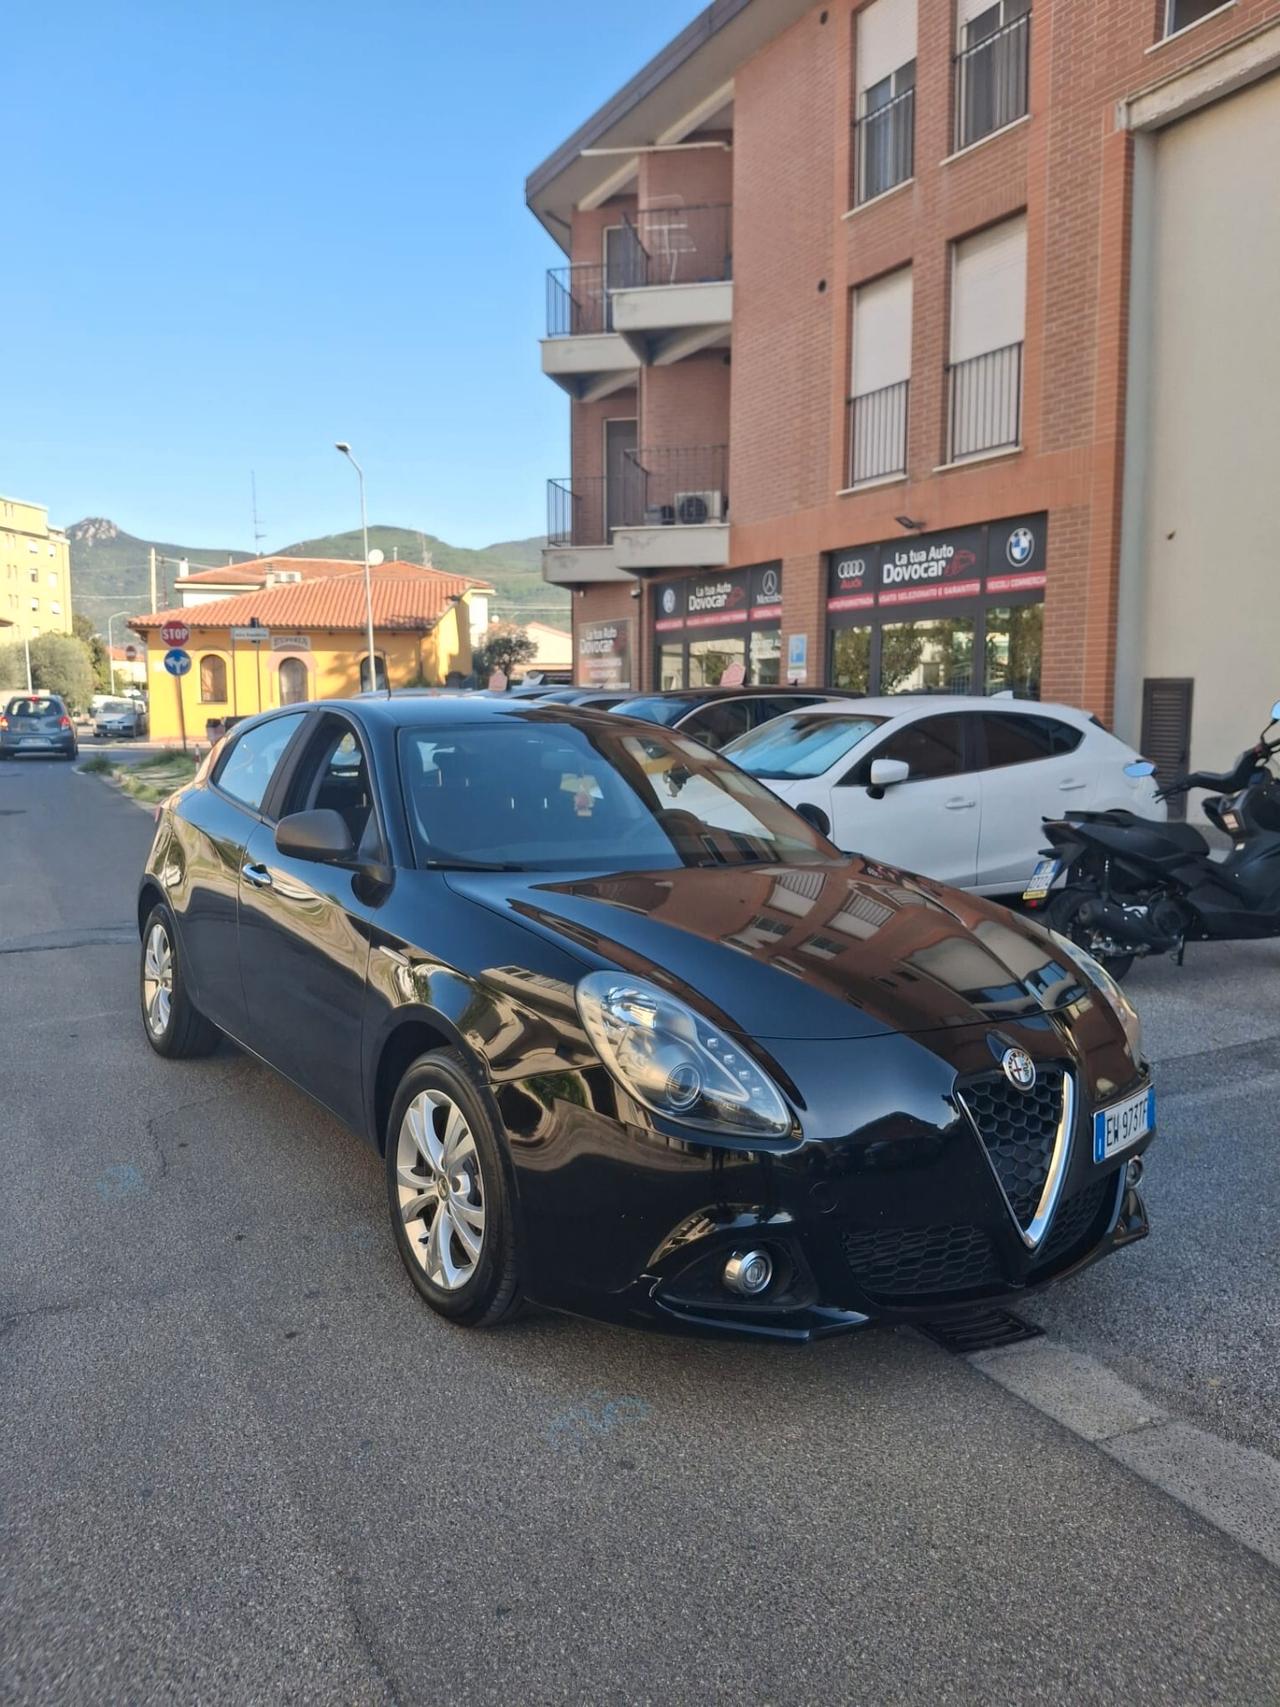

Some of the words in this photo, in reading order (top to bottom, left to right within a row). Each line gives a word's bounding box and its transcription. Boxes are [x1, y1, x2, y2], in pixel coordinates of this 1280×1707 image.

[895, 552, 908, 565] La
[909, 550, 927, 563] tua
[928, 544, 954, 561] Auto
[883, 560, 946, 584] Dovocar
[695, 586, 704, 597] La
[705, 585, 715, 596] tua
[716, 582, 732, 594] Auto
[689, 594, 728, 611] Dovocar
[162, 628, 188, 641] STOP
